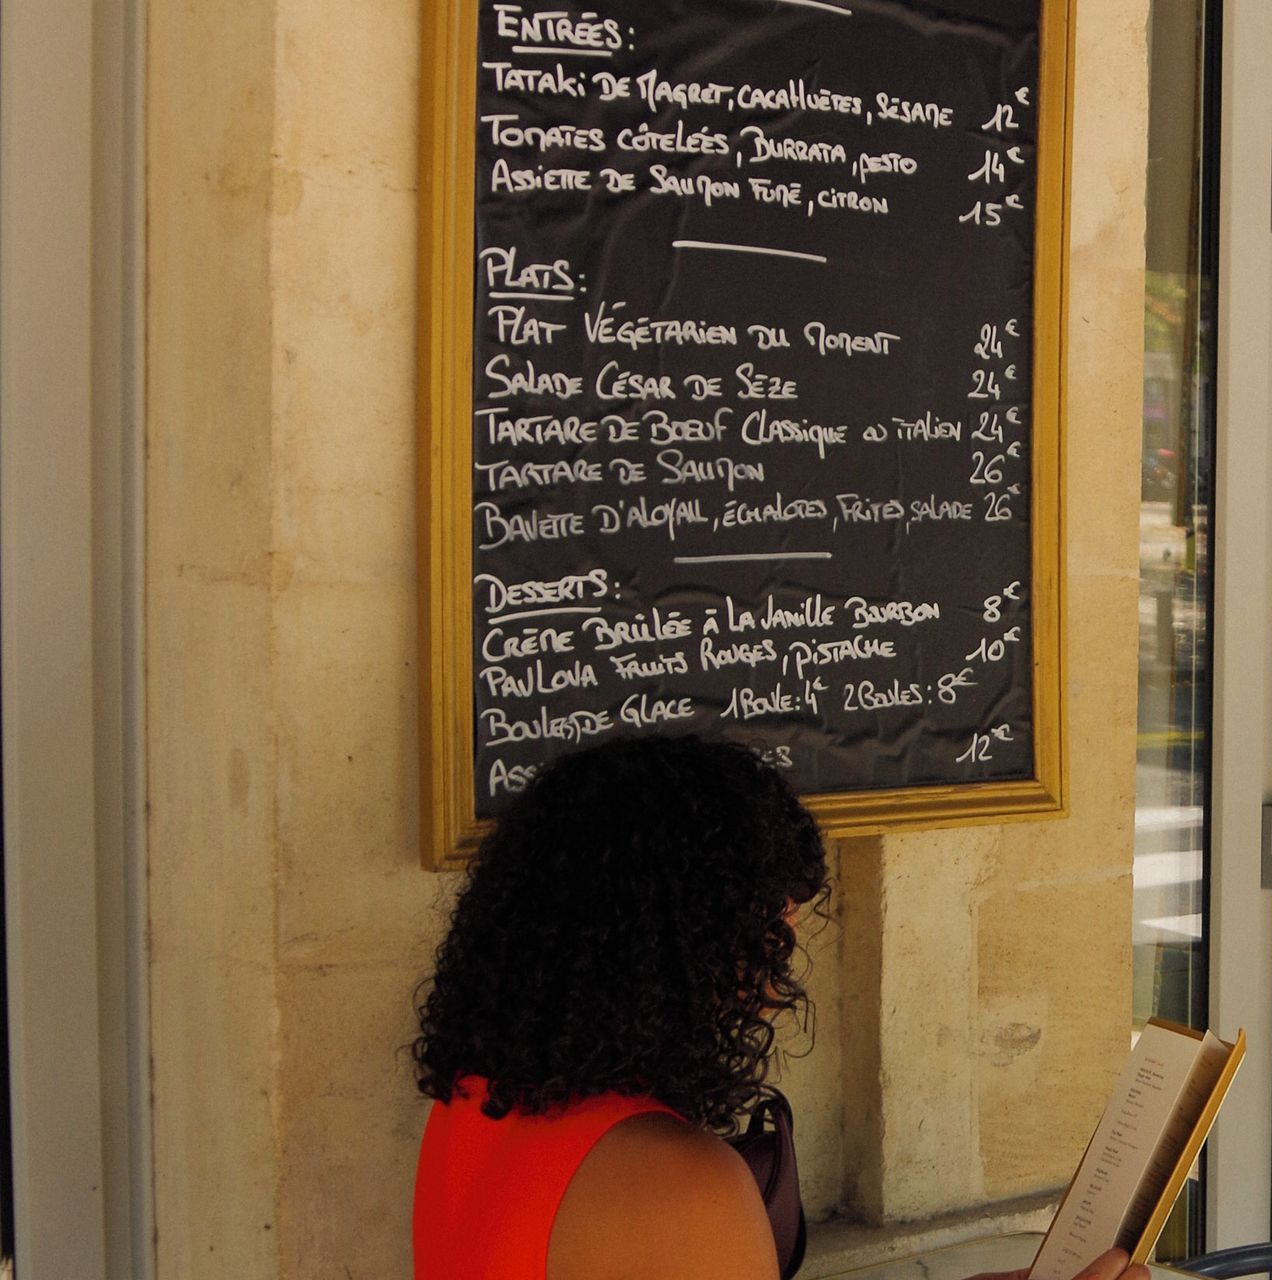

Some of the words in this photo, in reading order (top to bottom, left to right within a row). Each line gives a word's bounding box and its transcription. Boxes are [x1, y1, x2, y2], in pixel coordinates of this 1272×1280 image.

[591, 71, 632, 101] DE
[875, 91, 954, 129] SÉSAME
[480, 114, 607, 153] TOMATES
[491, 157, 593, 193] ASSIETTE
[599, 167, 636, 194] DE
[649, 164, 741, 207] SAUMON
[817, 187, 889, 214] CITRON
[487, 305, 568, 346] PLAT
[584, 300, 738, 351] VÉGÉTARIEN
[747, 324, 791, 351] DU
[803, 321, 901, 357] MOMENT
[485, 353, 584, 400] SALADE
[595, 360, 677, 400] CÉSAR
[683, 373, 724, 401] DE
[474, 406, 599, 447] TARTARE
[600, 414, 641, 443] DE
[741, 408, 848, 460] CLASSIQUE
[474, 458, 603, 492] TARTARE
[608, 457, 648, 486] DE
[656, 448, 765, 493] SAUMON
[473, 501, 586, 551] BAVETTE
[910, 493, 974, 522] SALADE
[725, 595, 756, 632] LA
[843, 595, 941, 629] BOURBON
[479, 658, 599, 698] PAVLOVA
[609, 651, 689, 680] FRUITS
[788, 634, 897, 680] PISTACHE
[568, 710, 615, 735] DE
[620, 693, 696, 728] GLACE
